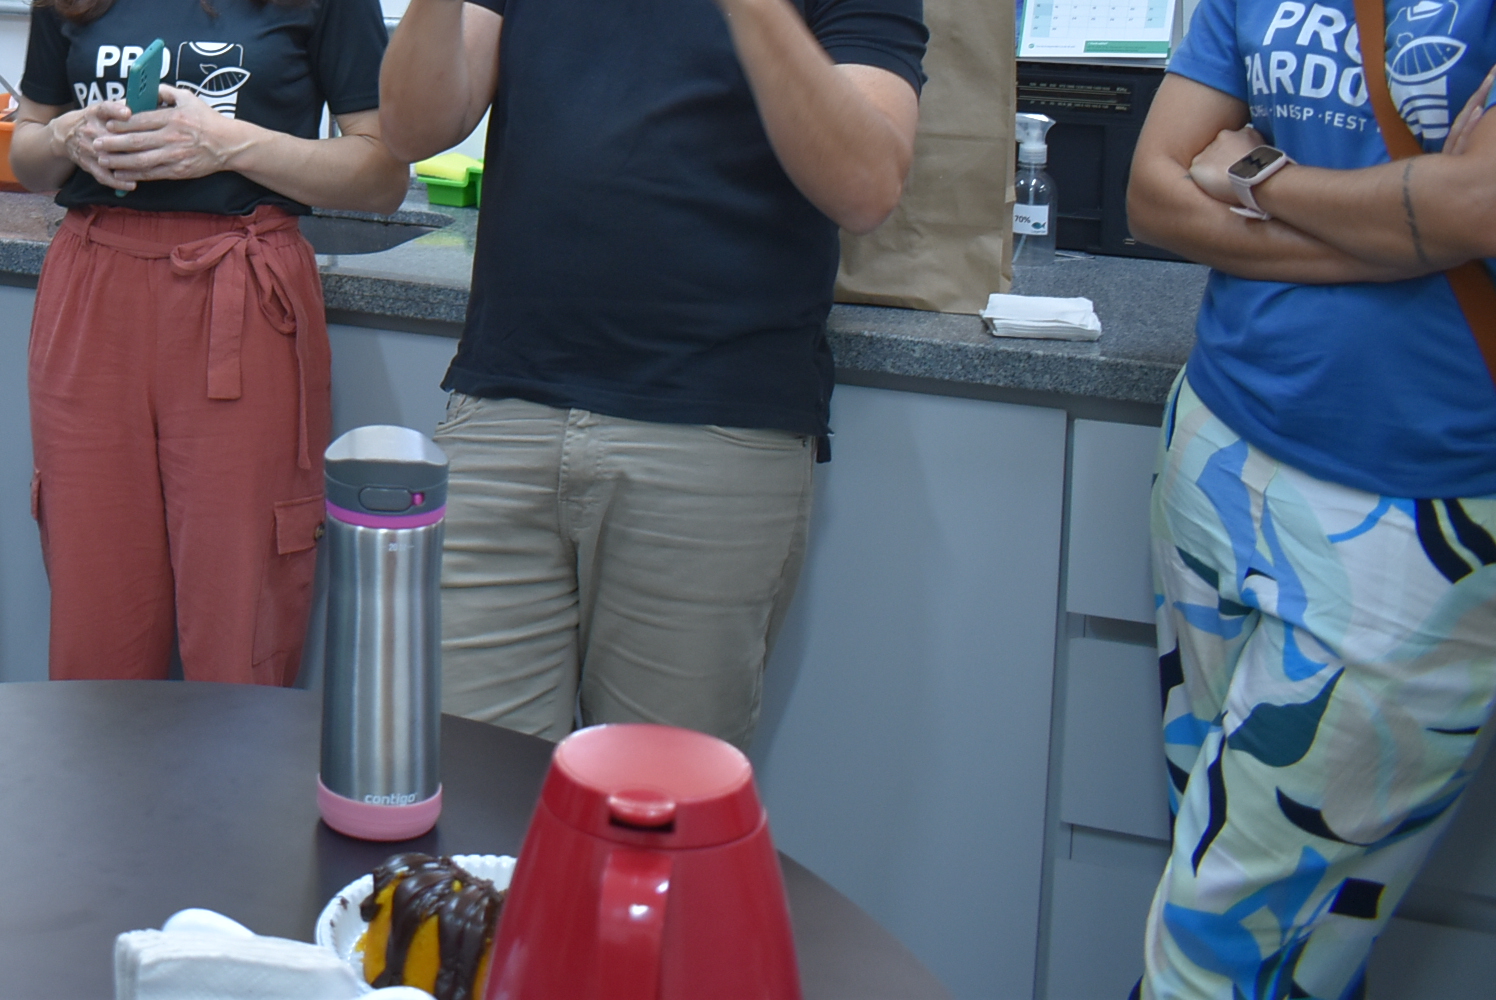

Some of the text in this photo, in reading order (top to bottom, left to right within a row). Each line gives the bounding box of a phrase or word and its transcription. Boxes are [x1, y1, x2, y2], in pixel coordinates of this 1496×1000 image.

[1325, 111, 1367, 132] FEST
[1014, 215, 1031, 224] 70%
[364, 792, 416, 807] contigo
